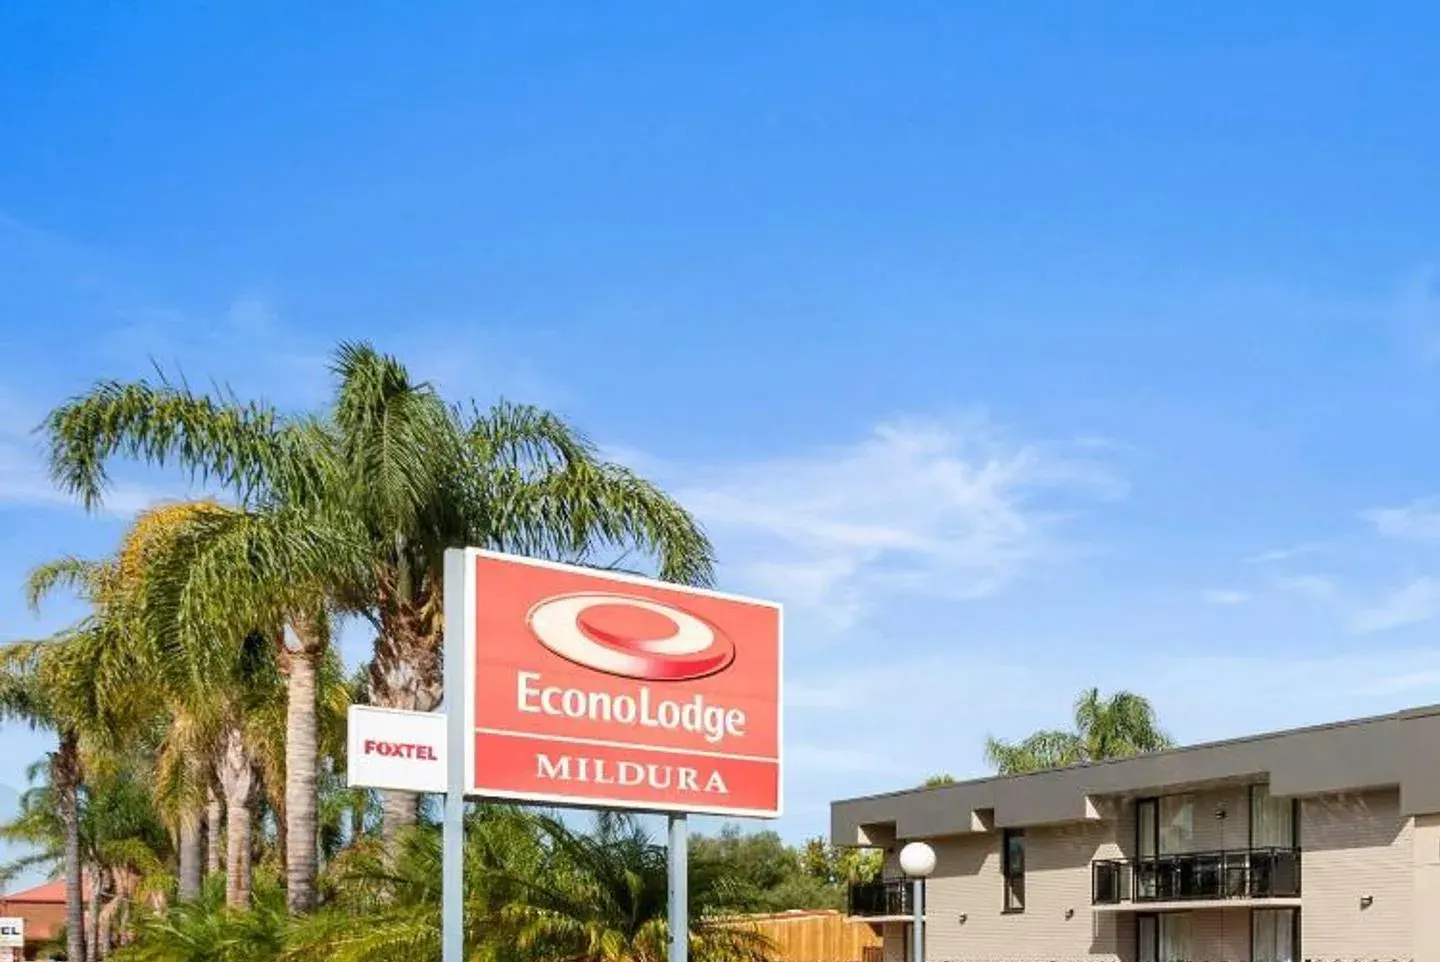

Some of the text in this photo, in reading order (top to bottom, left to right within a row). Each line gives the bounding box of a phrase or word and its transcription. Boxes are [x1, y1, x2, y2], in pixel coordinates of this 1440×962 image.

[517, 670, 746, 743] EconoLodge
[364, 739, 438, 761] FOXTEL
[536, 753, 728, 794] MILDURA
